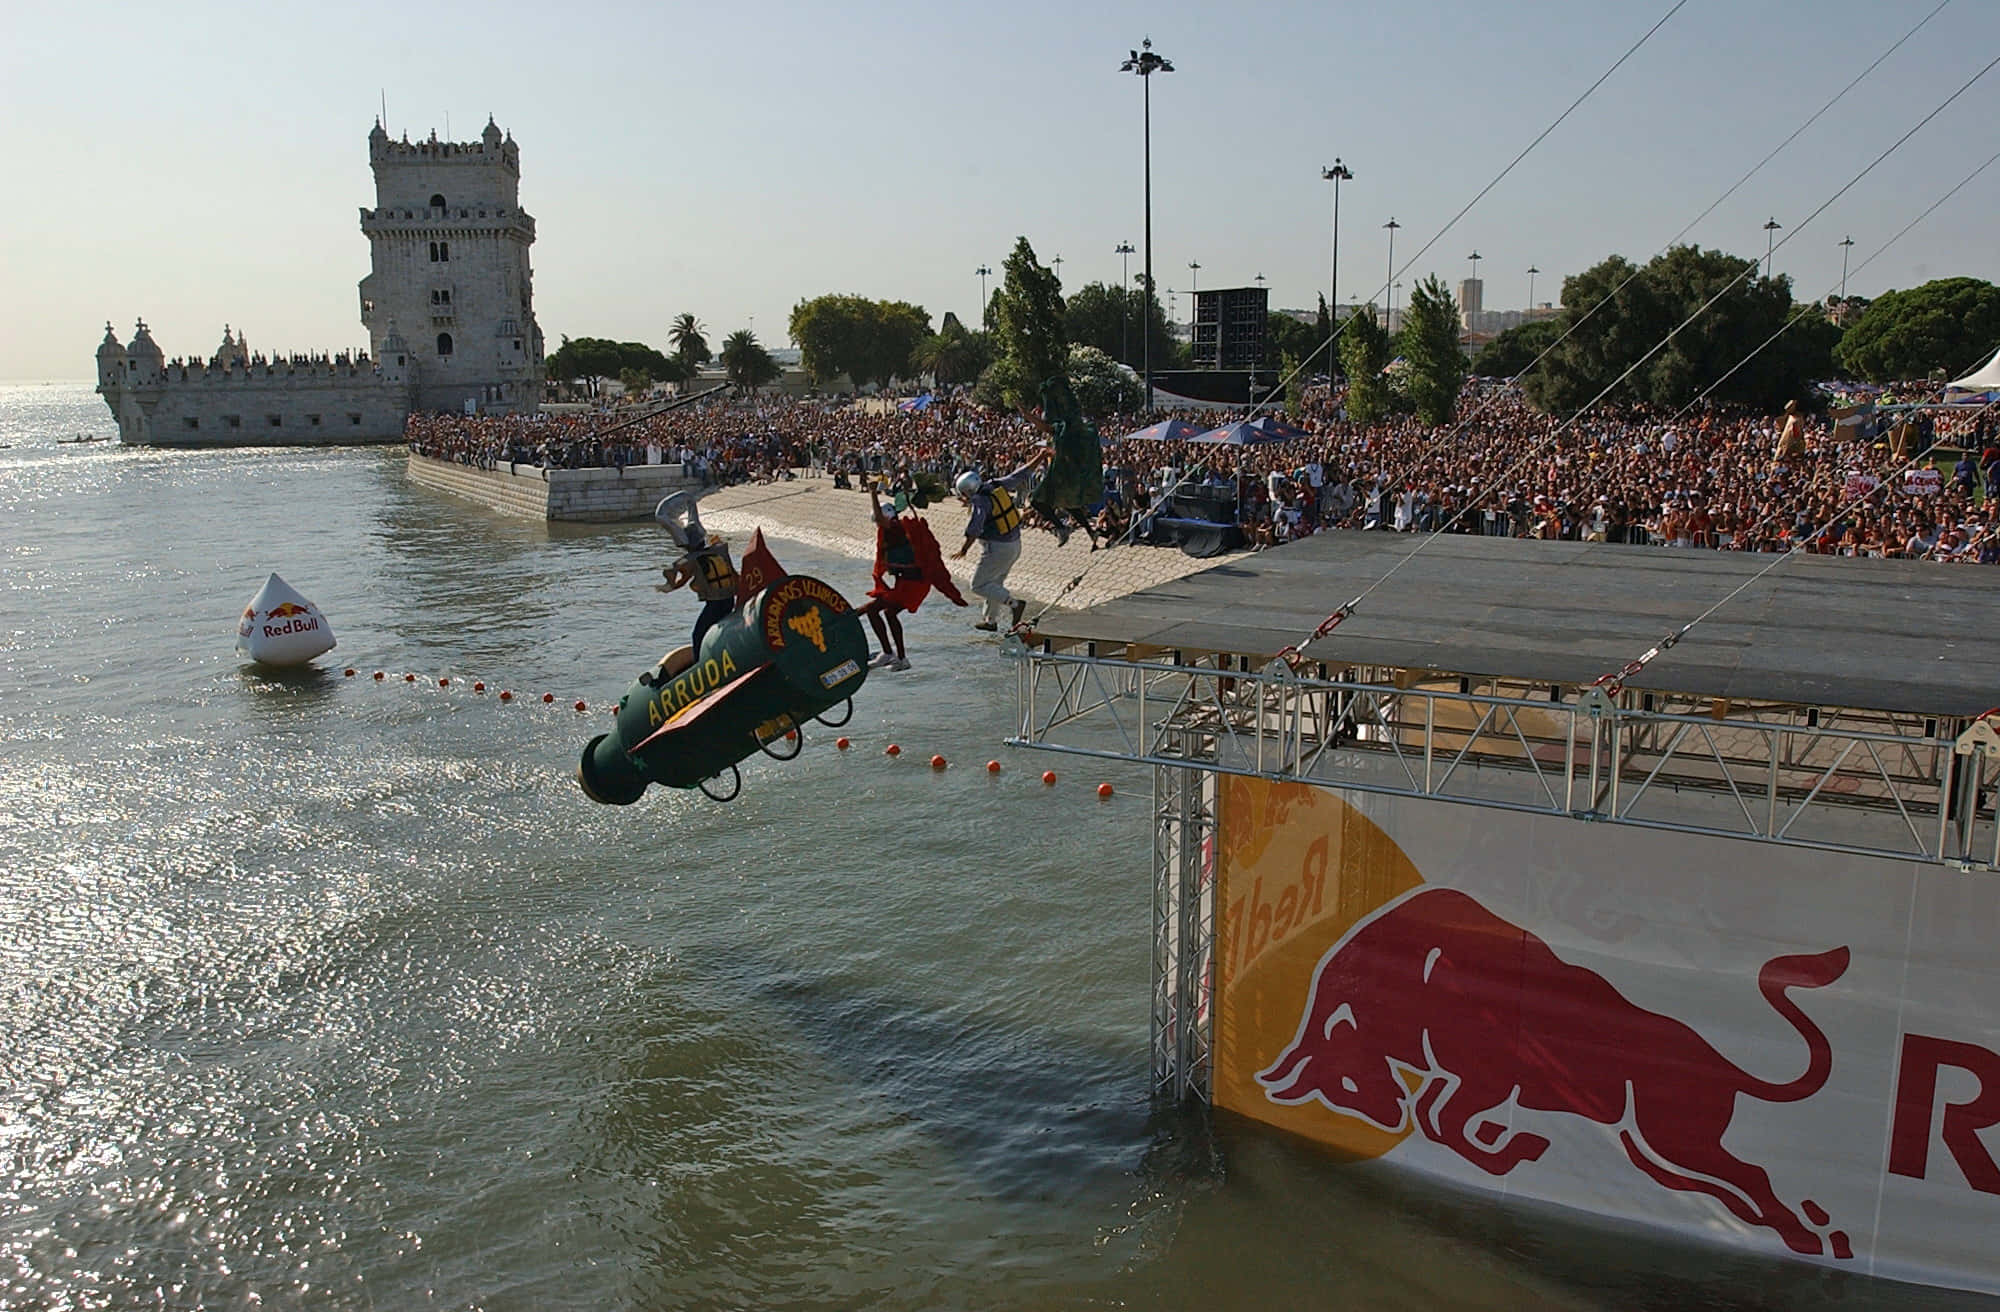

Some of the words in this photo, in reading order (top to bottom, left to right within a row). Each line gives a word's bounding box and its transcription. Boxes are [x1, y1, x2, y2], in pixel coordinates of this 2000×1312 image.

[746, 567, 763, 591] 29
[263, 619, 292, 638] Red
[293, 617, 319, 633] Bull
[648, 648, 737, 728] ARRUDA
